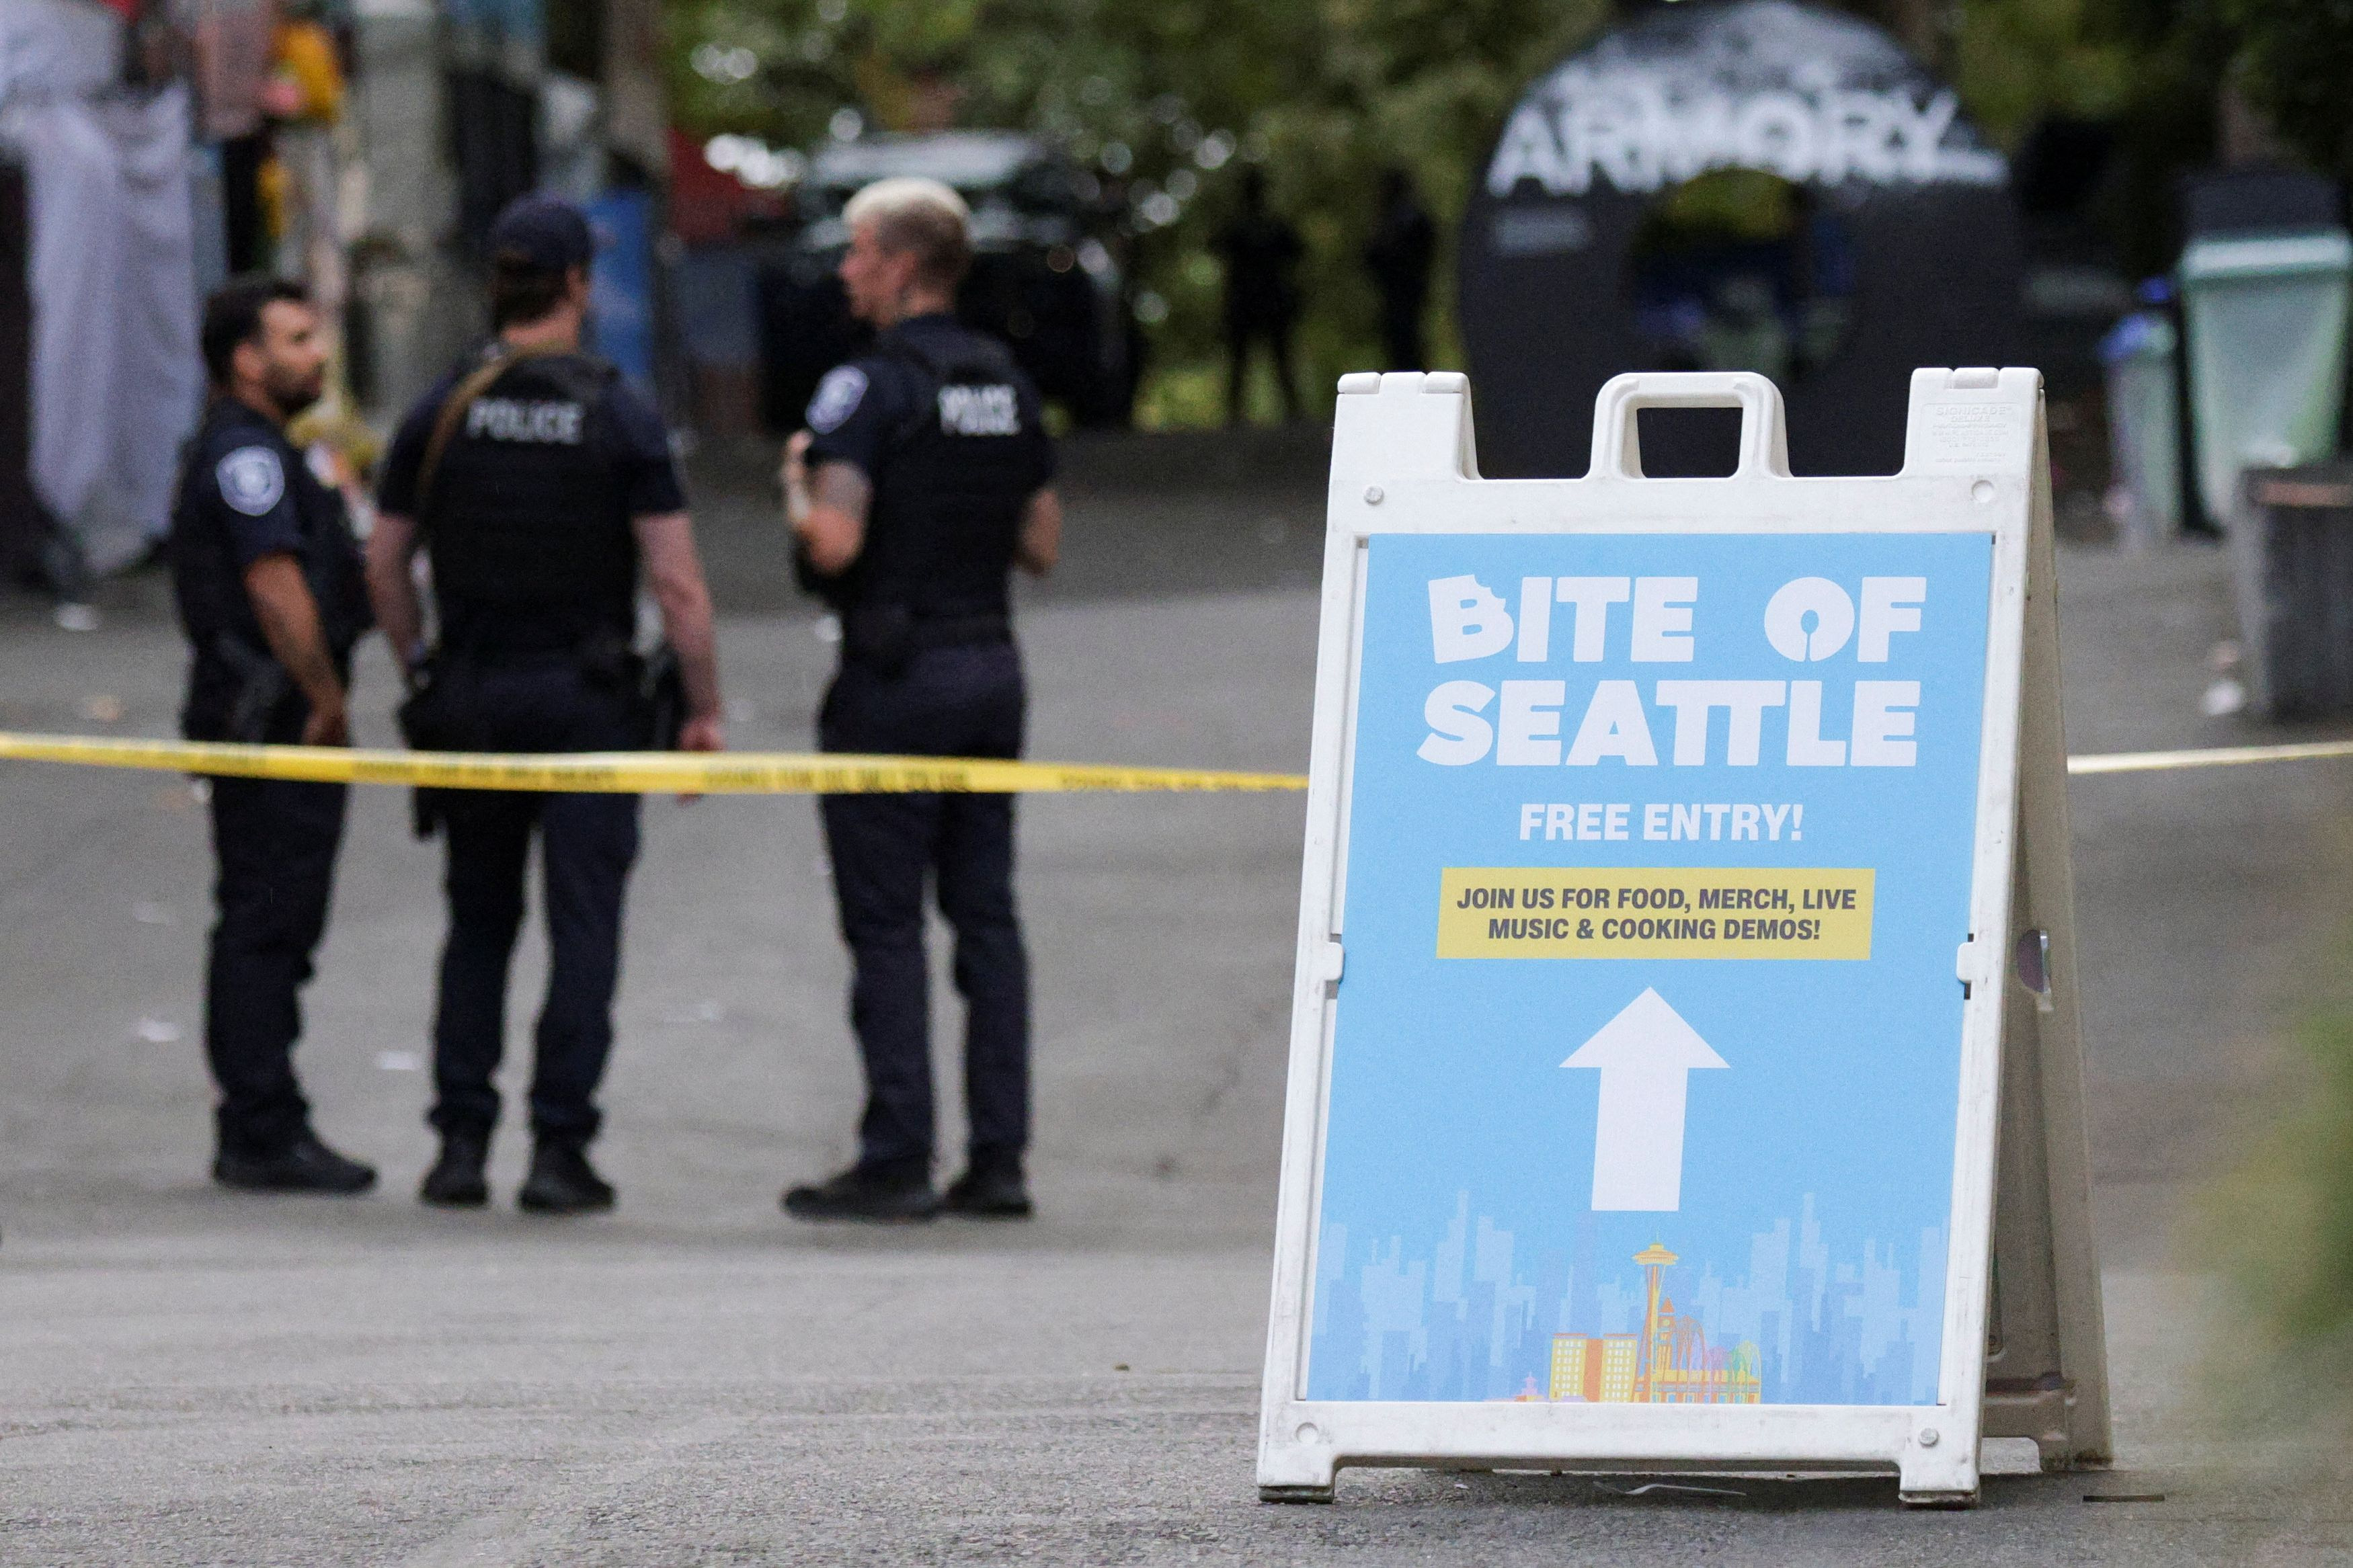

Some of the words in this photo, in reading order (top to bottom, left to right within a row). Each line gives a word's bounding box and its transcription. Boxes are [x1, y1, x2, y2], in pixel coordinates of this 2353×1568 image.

[1486, 87, 1963, 198] ARMORY
[468, 398, 584, 444] POLICE
[1427, 575, 1700, 665] BITE
[1763, 576, 1928, 664] OF
[1417, 679, 1922, 768] SEATTLE
[1519, 803, 1632, 841] FREE
[1643, 803, 1804, 841] ENTRY!
[1457, 889, 1516, 911] JOIN
[1521, 889, 1556, 911] US
[1562, 889, 1611, 911] FOR
[1618, 889, 1692, 915] FOOD,
[1698, 889, 1796, 915] MERCH,
[1802, 889, 1858, 911] LIVE
[1488, 919, 1570, 940] MUSIC
[1576, 919, 1595, 940] &
[1602, 919, 1718, 941] COOKING
[1723, 919, 1822, 941] DEMOS!
